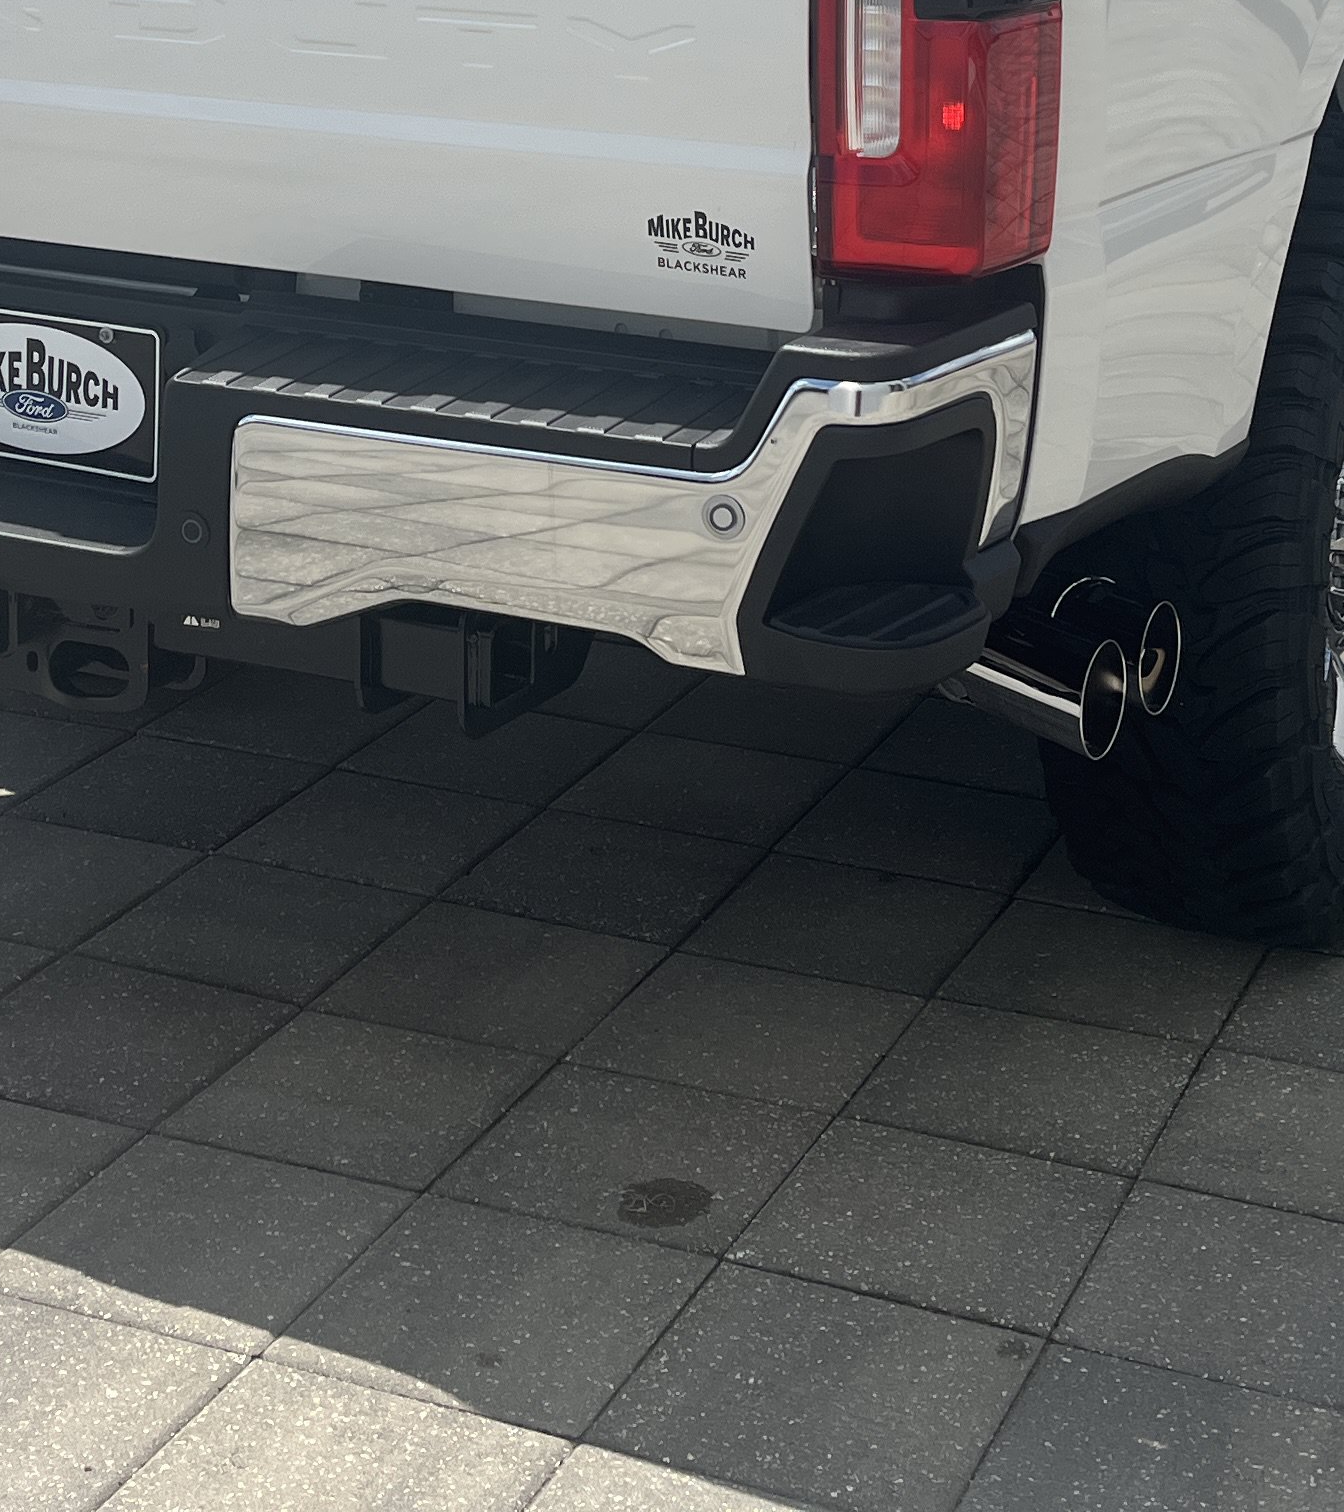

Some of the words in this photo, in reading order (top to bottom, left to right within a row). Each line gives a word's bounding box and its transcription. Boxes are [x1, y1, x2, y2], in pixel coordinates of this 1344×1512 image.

[647, 214, 693, 240] MIKE
[694, 210, 755, 250] BURCH
[657, 256, 747, 279] BLACKSHEAR
[26, 337, 119, 411] BURCH
[15, 393, 55, 419] Ford
